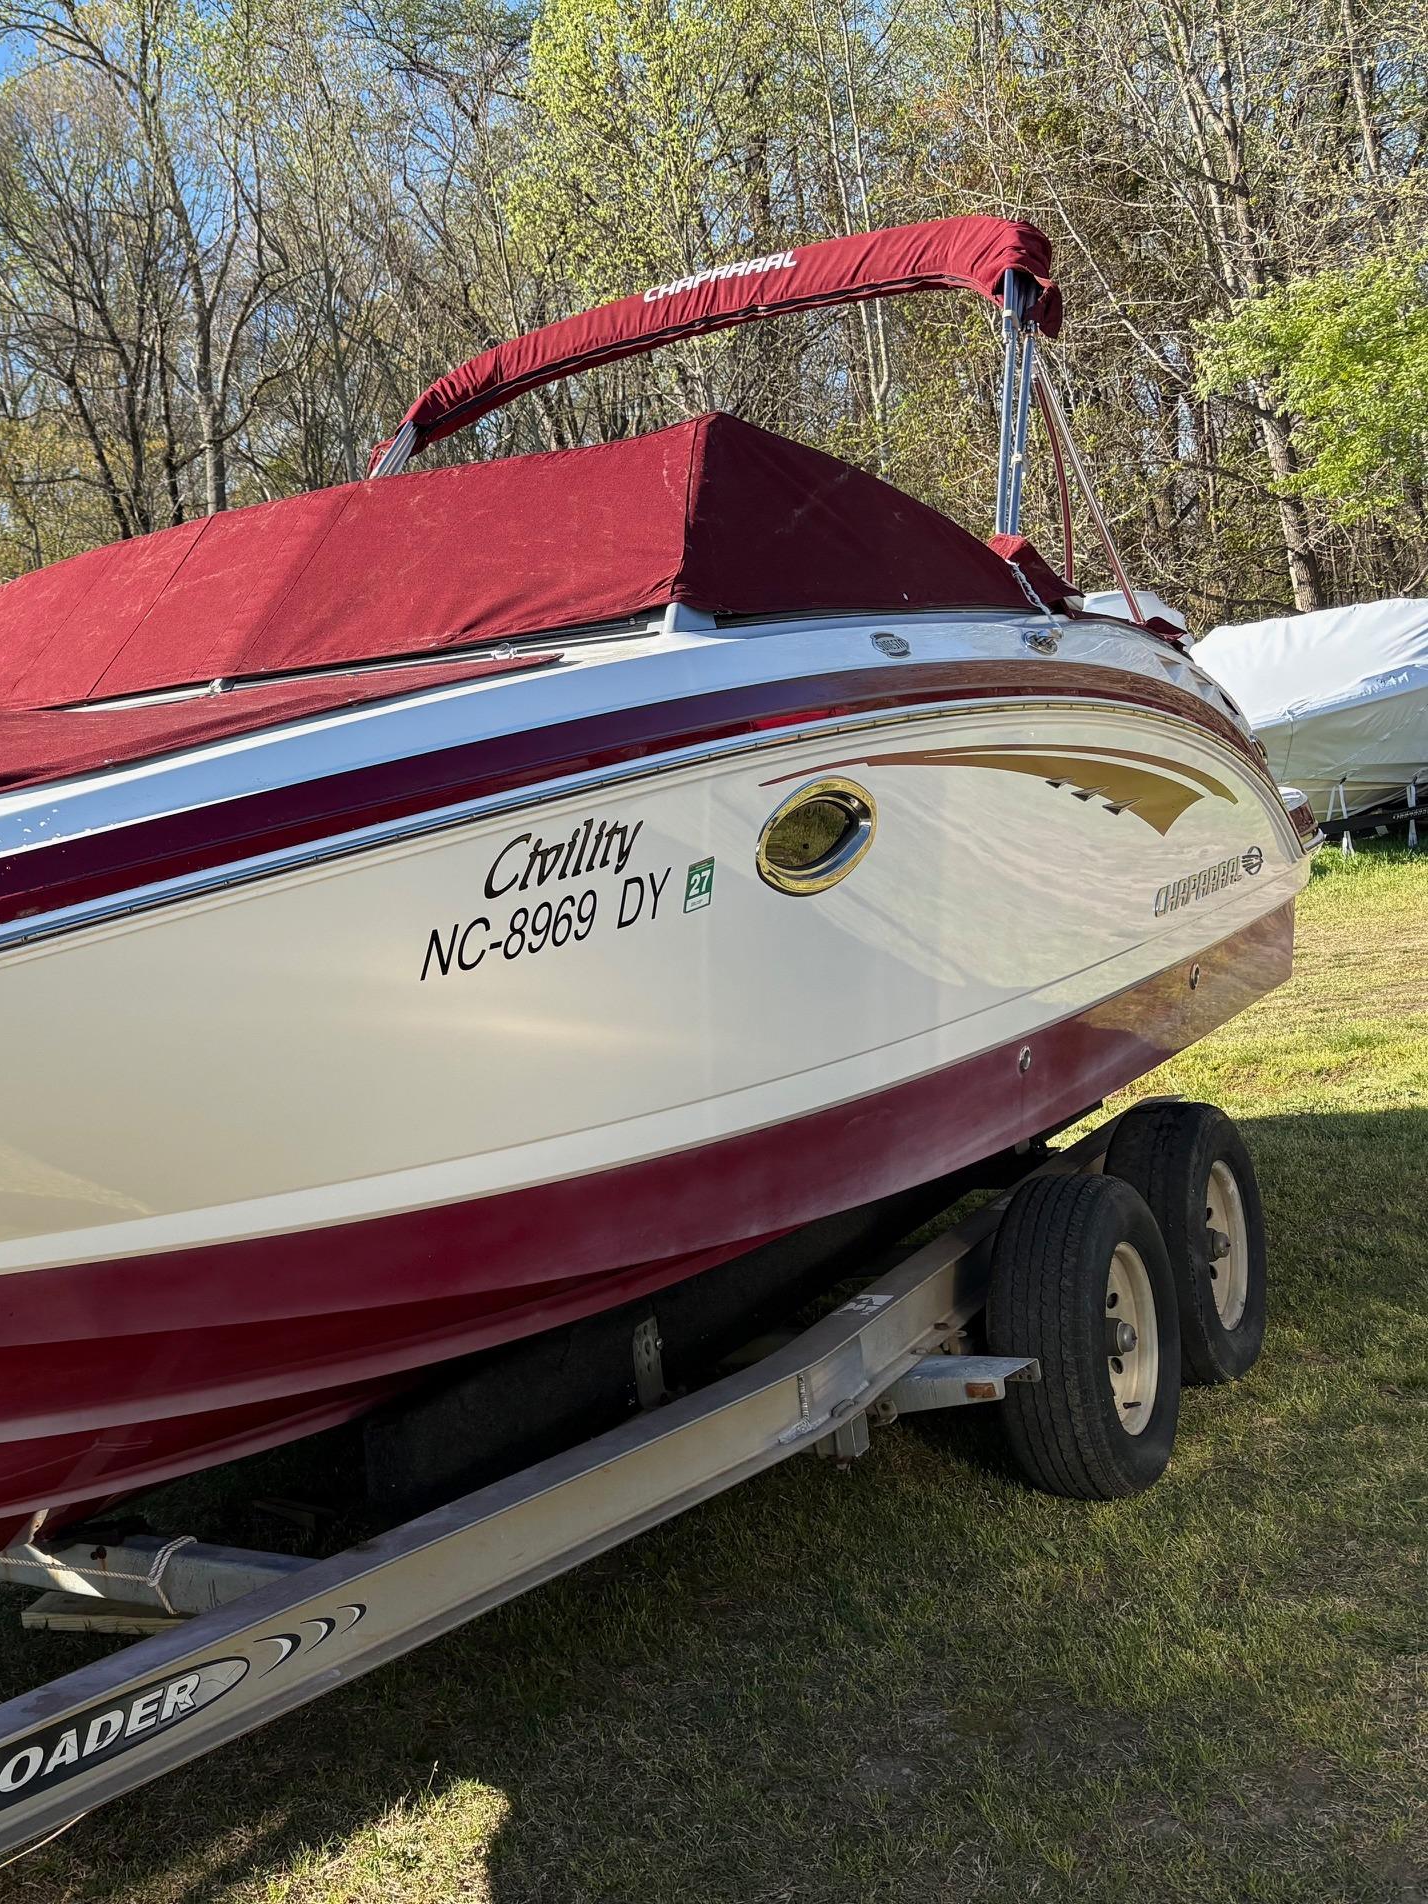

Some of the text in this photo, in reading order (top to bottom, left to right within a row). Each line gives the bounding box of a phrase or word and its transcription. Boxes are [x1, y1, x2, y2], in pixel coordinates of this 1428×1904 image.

[644, 251, 797, 302] CHAPARRAL
[484, 818, 644, 899] Civility
[689, 869, 711, 897] 27
[420, 867, 672, 981] NC-8969 DY
